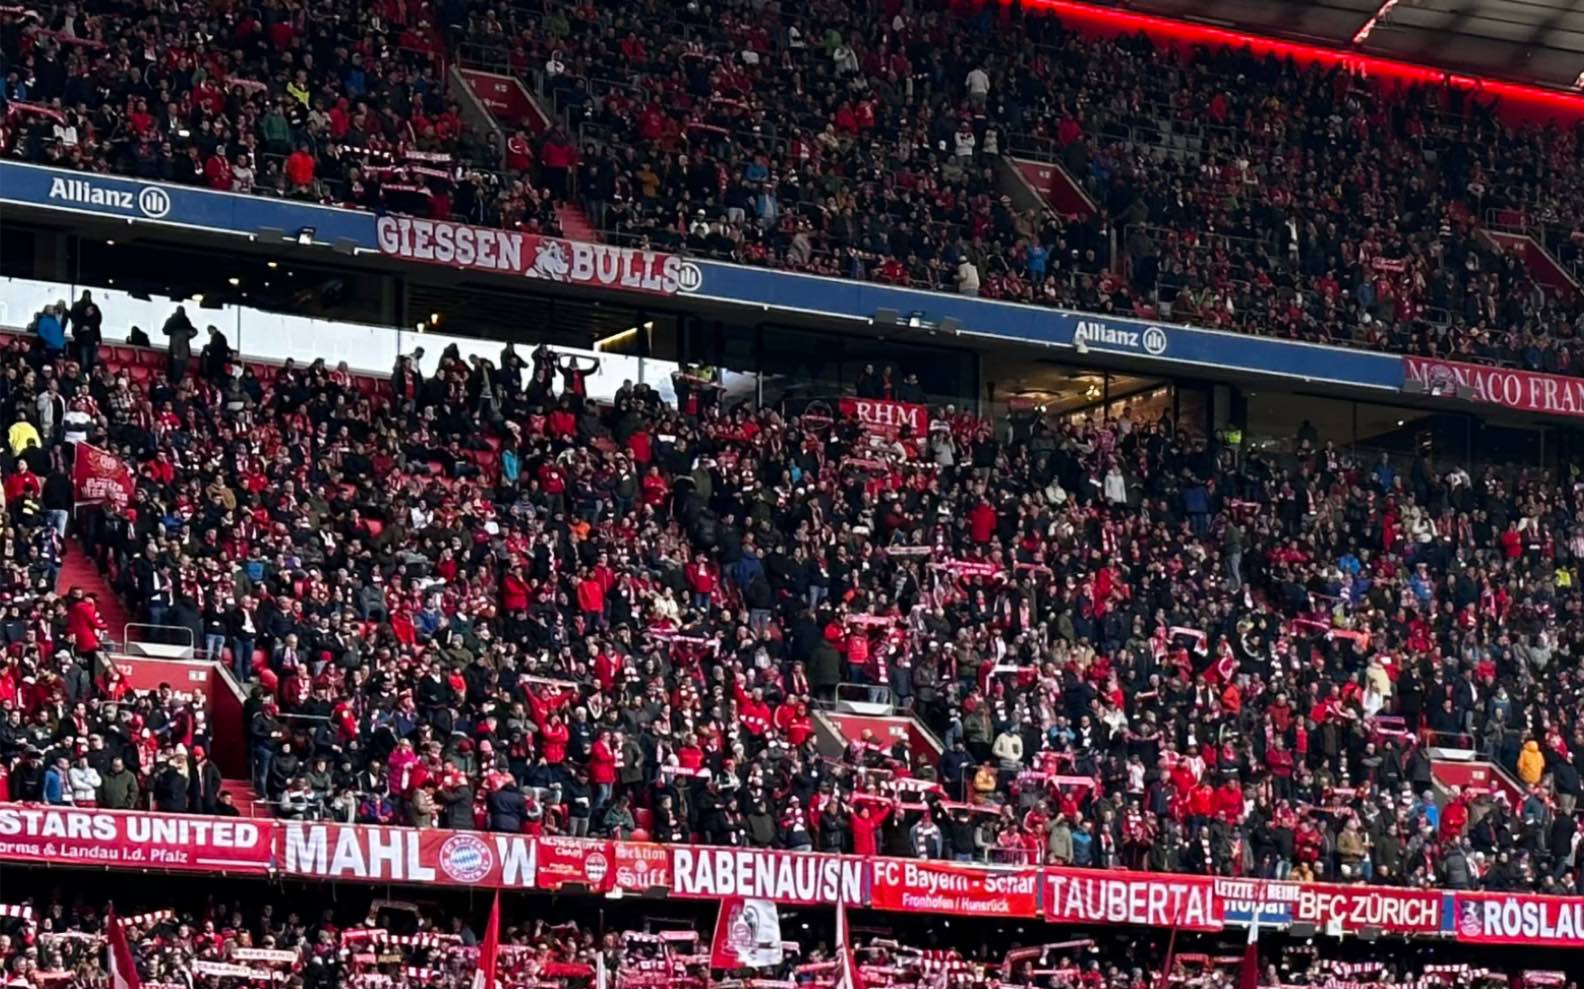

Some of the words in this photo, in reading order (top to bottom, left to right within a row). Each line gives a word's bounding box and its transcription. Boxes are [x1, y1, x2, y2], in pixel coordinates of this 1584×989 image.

[50, 176, 133, 209] Allianz
[376, 216, 524, 271] GIESSEN
[571, 240, 682, 293] BULLS
[1075, 320, 1139, 348] Allianz
[854, 401, 919, 429] RHM
[0, 809, 117, 841] STARS
[126, 815, 259, 849] UNITED
[60, 843, 118, 860] Landau
[150, 848, 188, 864] Pfalz
[674, 848, 862, 904] RABENAU/SN
[873, 861, 899, 886] FC
[904, 863, 968, 894] Bayern
[1214, 878, 1254, 899] LETZTE
[1047, 875, 1223, 927] TAUBERTAL
[1299, 891, 1347, 924] BFC
[1350, 894, 1438, 927] ZÜRICH
